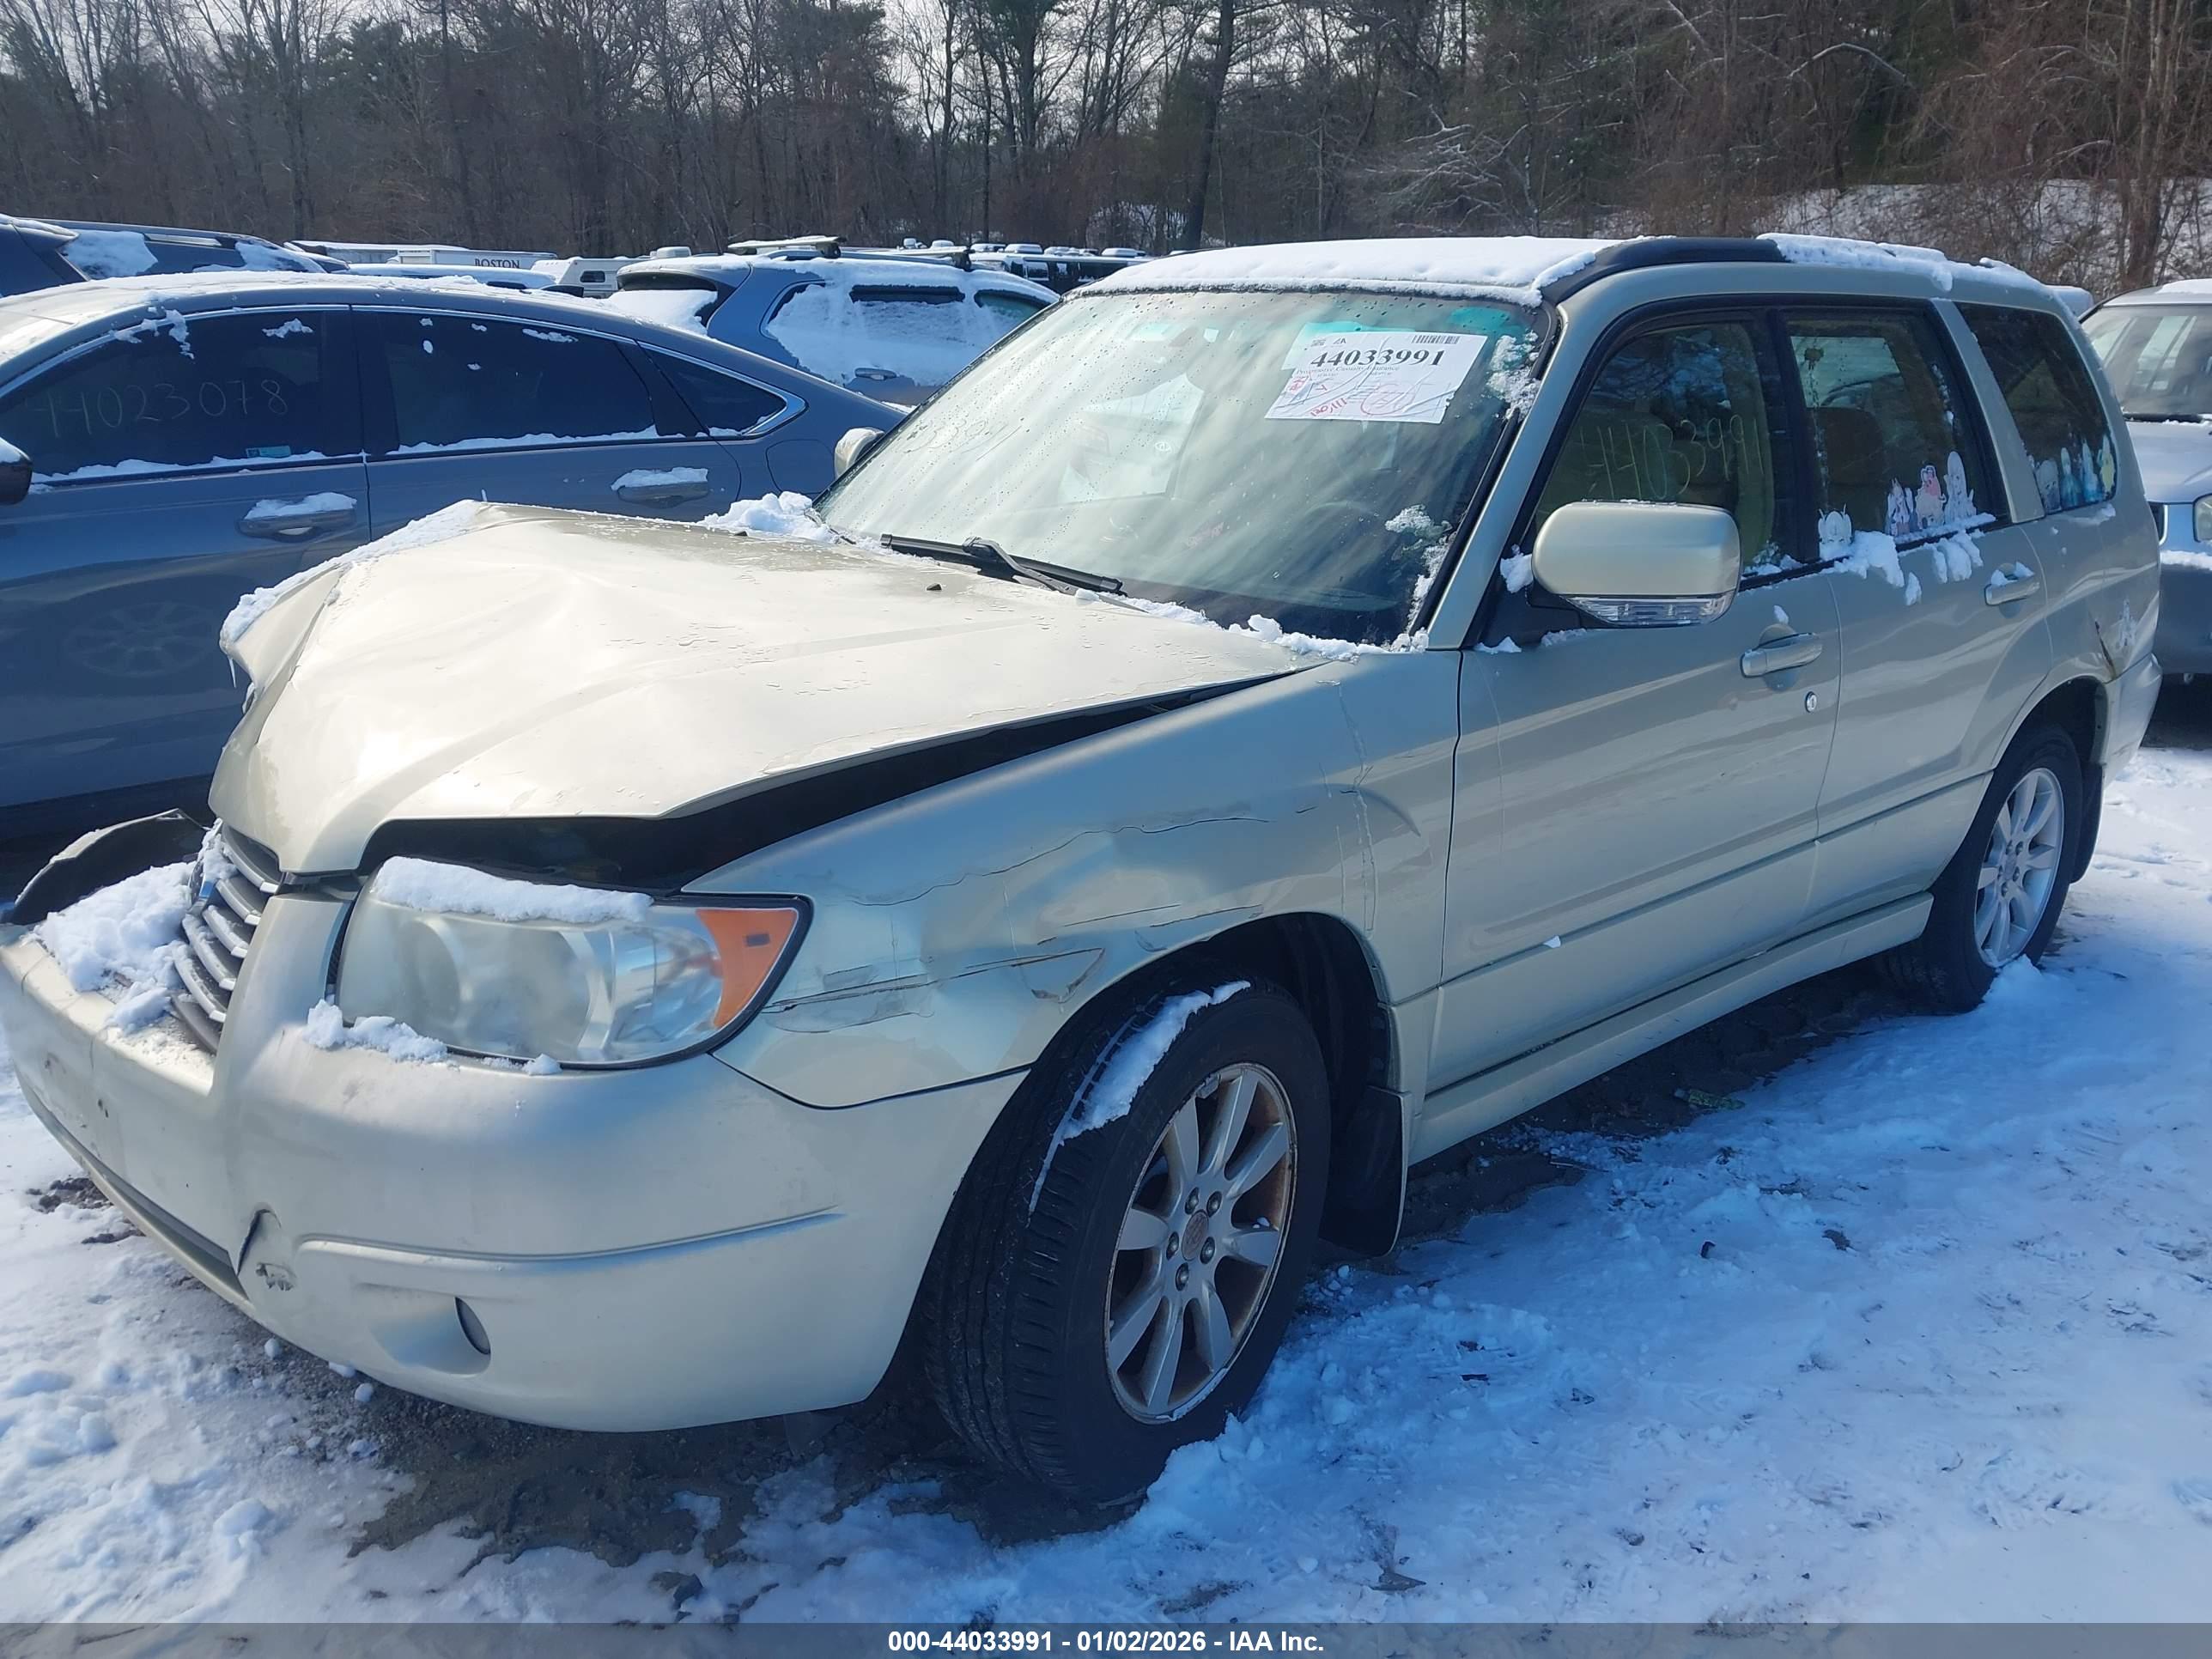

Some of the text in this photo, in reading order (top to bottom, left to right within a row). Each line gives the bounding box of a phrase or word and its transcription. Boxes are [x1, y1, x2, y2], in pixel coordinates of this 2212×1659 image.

[475, 258, 520, 269] BOSTON
[1310, 349, 1446, 368] 44033991
[1579, 414, 1764, 500] 44033991
